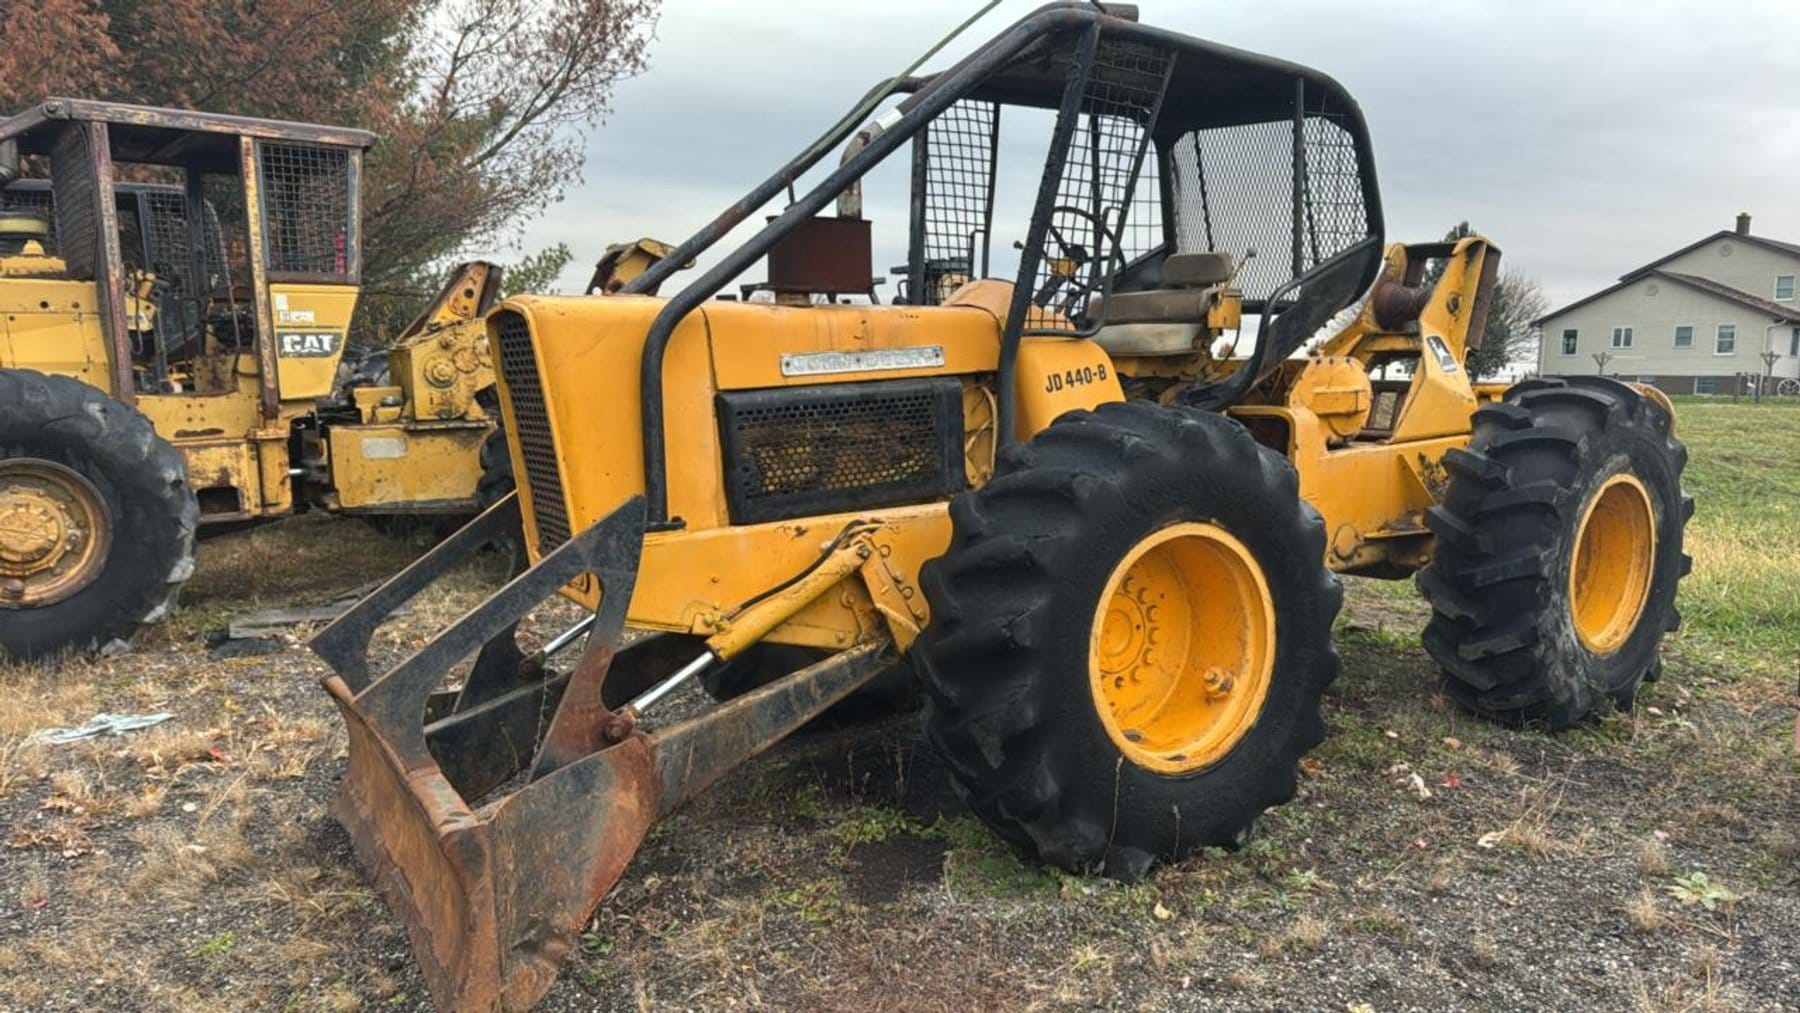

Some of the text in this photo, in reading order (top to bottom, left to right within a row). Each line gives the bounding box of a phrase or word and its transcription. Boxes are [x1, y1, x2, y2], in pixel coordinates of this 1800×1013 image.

[282, 334, 335, 353] CAT
[1046, 364, 1107, 393] JD 440-B
